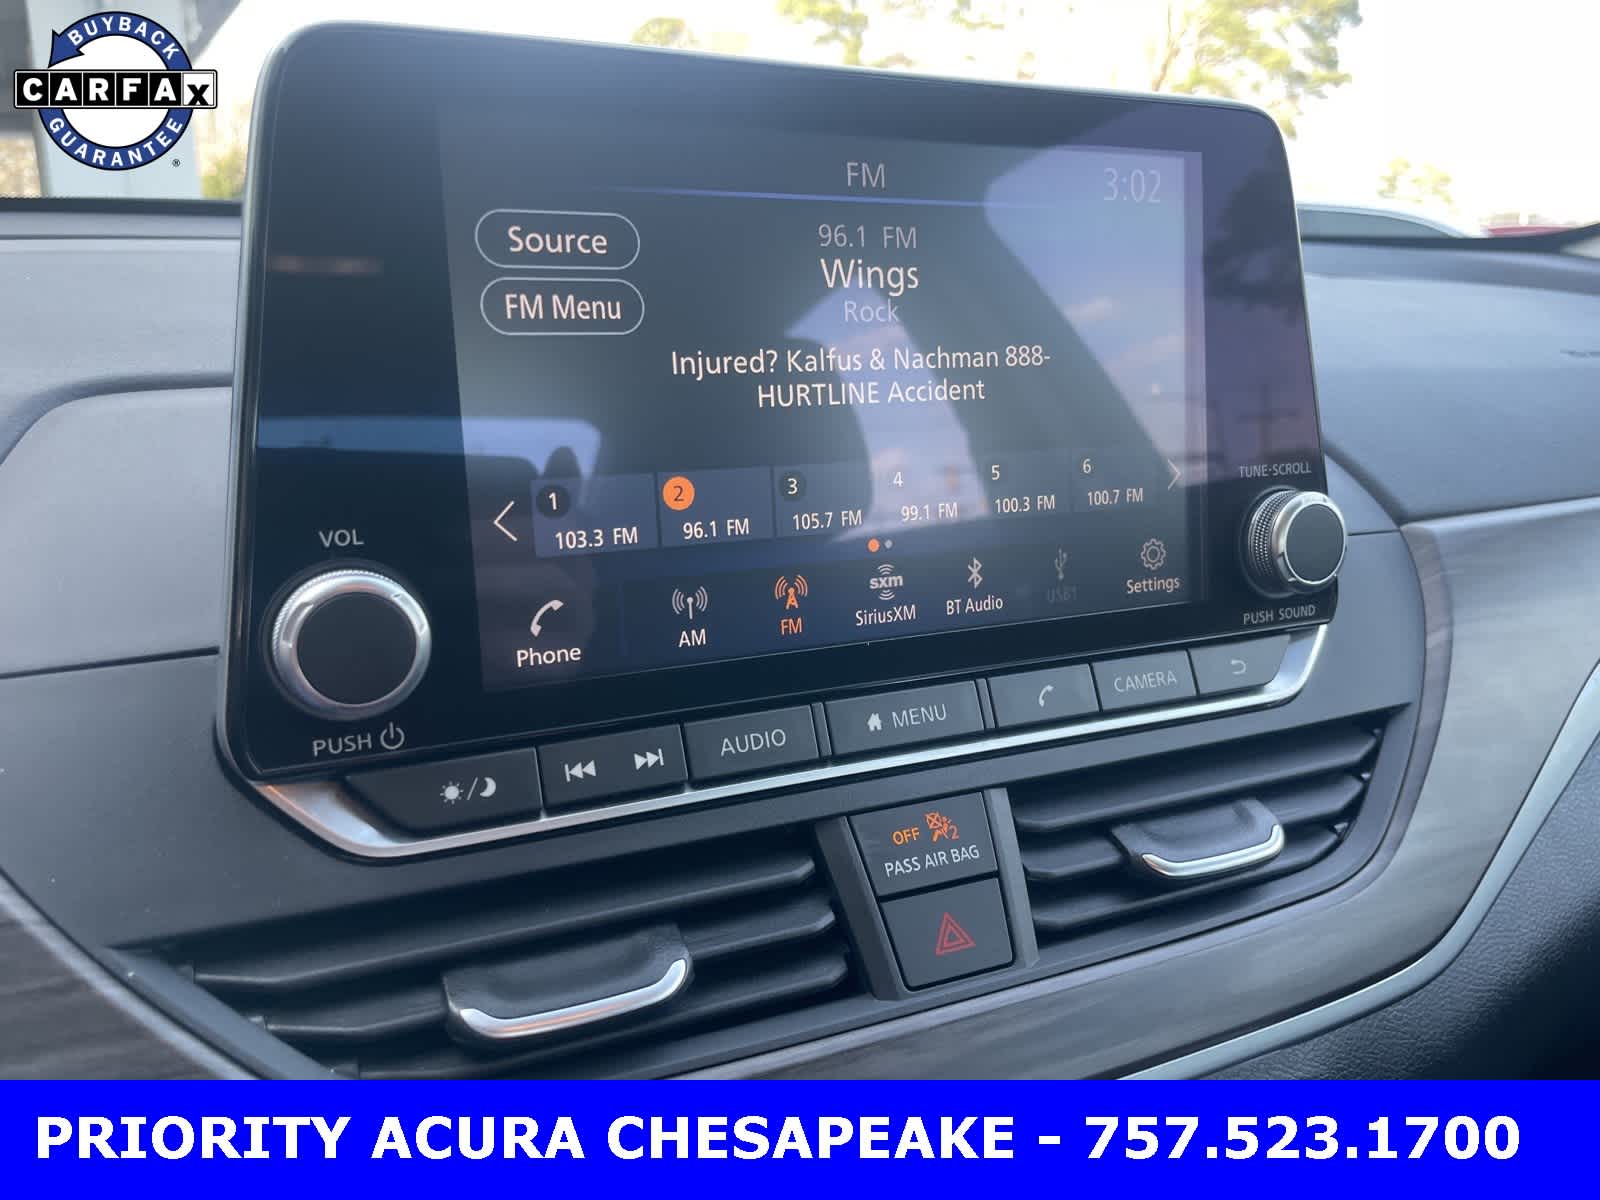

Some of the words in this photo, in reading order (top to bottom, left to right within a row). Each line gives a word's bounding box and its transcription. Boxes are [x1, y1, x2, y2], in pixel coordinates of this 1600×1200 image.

[846, 162, 886, 189] FM
[1103, 167, 1161, 204] 3:02
[507, 226, 608, 255] Source
[818, 223, 866, 248] 96.1
[882, 226, 917, 249] FM
[820, 258, 920, 297] Wings
[505, 293, 544, 320] FM
[551, 294, 622, 321] Menu
[844, 300, 900, 324] Rock
[671, 349, 779, 381] Injured?
[786, 348, 862, 373] Kalfus
[869, 348, 886, 372] &
[893, 346, 999, 371] Nachman
[1005, 344, 1051, 368] 888-
[757, 381, 880, 408] HURTLINE
[887, 378, 986, 404] Accident
[990, 465, 1001, 481] 5
[1082, 458, 1092, 474] 6
[786, 477, 799, 496] 3
[892, 471, 904, 488] 4
[548, 491, 558, 511] 1
[673, 485, 686, 502] 2
[994, 496, 1031, 514] 100.3
[1036, 494, 1056, 511] FM
[1087, 489, 1120, 506] 100.7
[1126, 487, 1144, 504] FM
[792, 512, 834, 531] 105.7
[841, 509, 863, 528] FM
[900, 504, 931, 522] 99.1
[938, 502, 959, 520] FM
[318, 529, 364, 548] VOL
[555, 528, 604, 550] 103.3
[612, 526, 639, 546] FM
[683, 521, 718, 540] 96.1
[726, 518, 750, 537] FM
[1126, 575, 1181, 594] Settings
[855, 604, 917, 627] SiriusXM
[946, 600, 963, 616] BT
[965, 594, 1004, 614] Audio
[1243, 610, 1275, 625] PUSH
[1279, 603, 1316, 621] SOUND
[780, 617, 803, 636] FM
[678, 629, 707, 648] AM
[516, 647, 582, 668] Phone
[1114, 670, 1178, 693] CAMERA
[891, 703, 948, 729] MENU
[312, 735, 372, 757] PUSH
[720, 728, 787, 757] AUDIO
[892, 827, 920, 846] OFF
[884, 856, 921, 878] PASS
[925, 850, 950, 870] AIR
[950, 844, 980, 863] BAG
